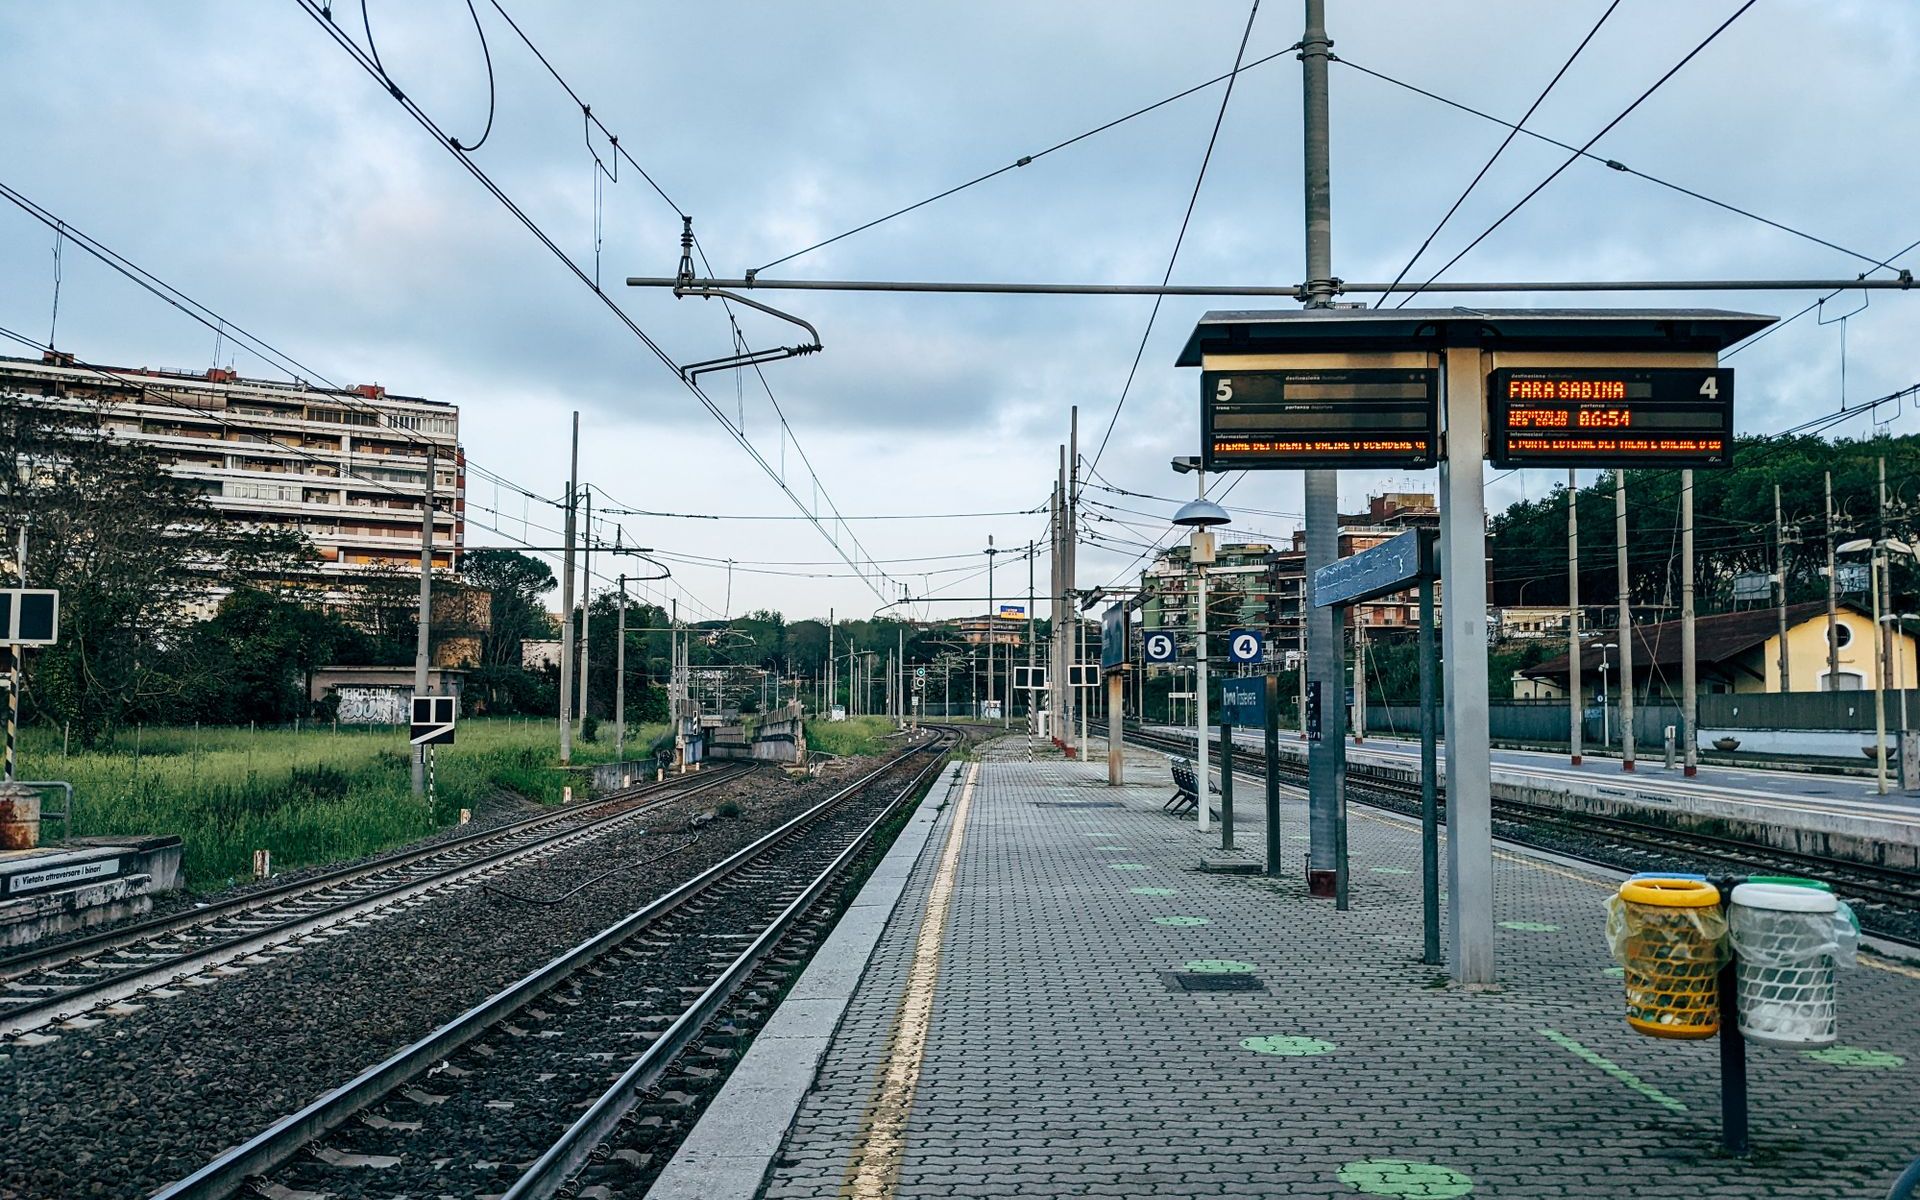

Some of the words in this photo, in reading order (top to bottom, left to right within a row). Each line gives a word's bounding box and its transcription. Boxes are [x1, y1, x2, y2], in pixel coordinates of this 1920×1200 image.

[1215, 378, 1233, 402] 5
[1510, 381, 1554, 399] FARA
[1558, 381, 1624, 399] SABINA
[1699, 376, 1719, 399] 4
[1579, 410, 1629, 426] 06:54
[1153, 637, 1166, 656] 5
[1238, 638, 1252, 655] 4
[22, 875, 45, 885] Vietato
[45, 869, 81, 881] attraversare
[84, 864, 102, 875] binari
